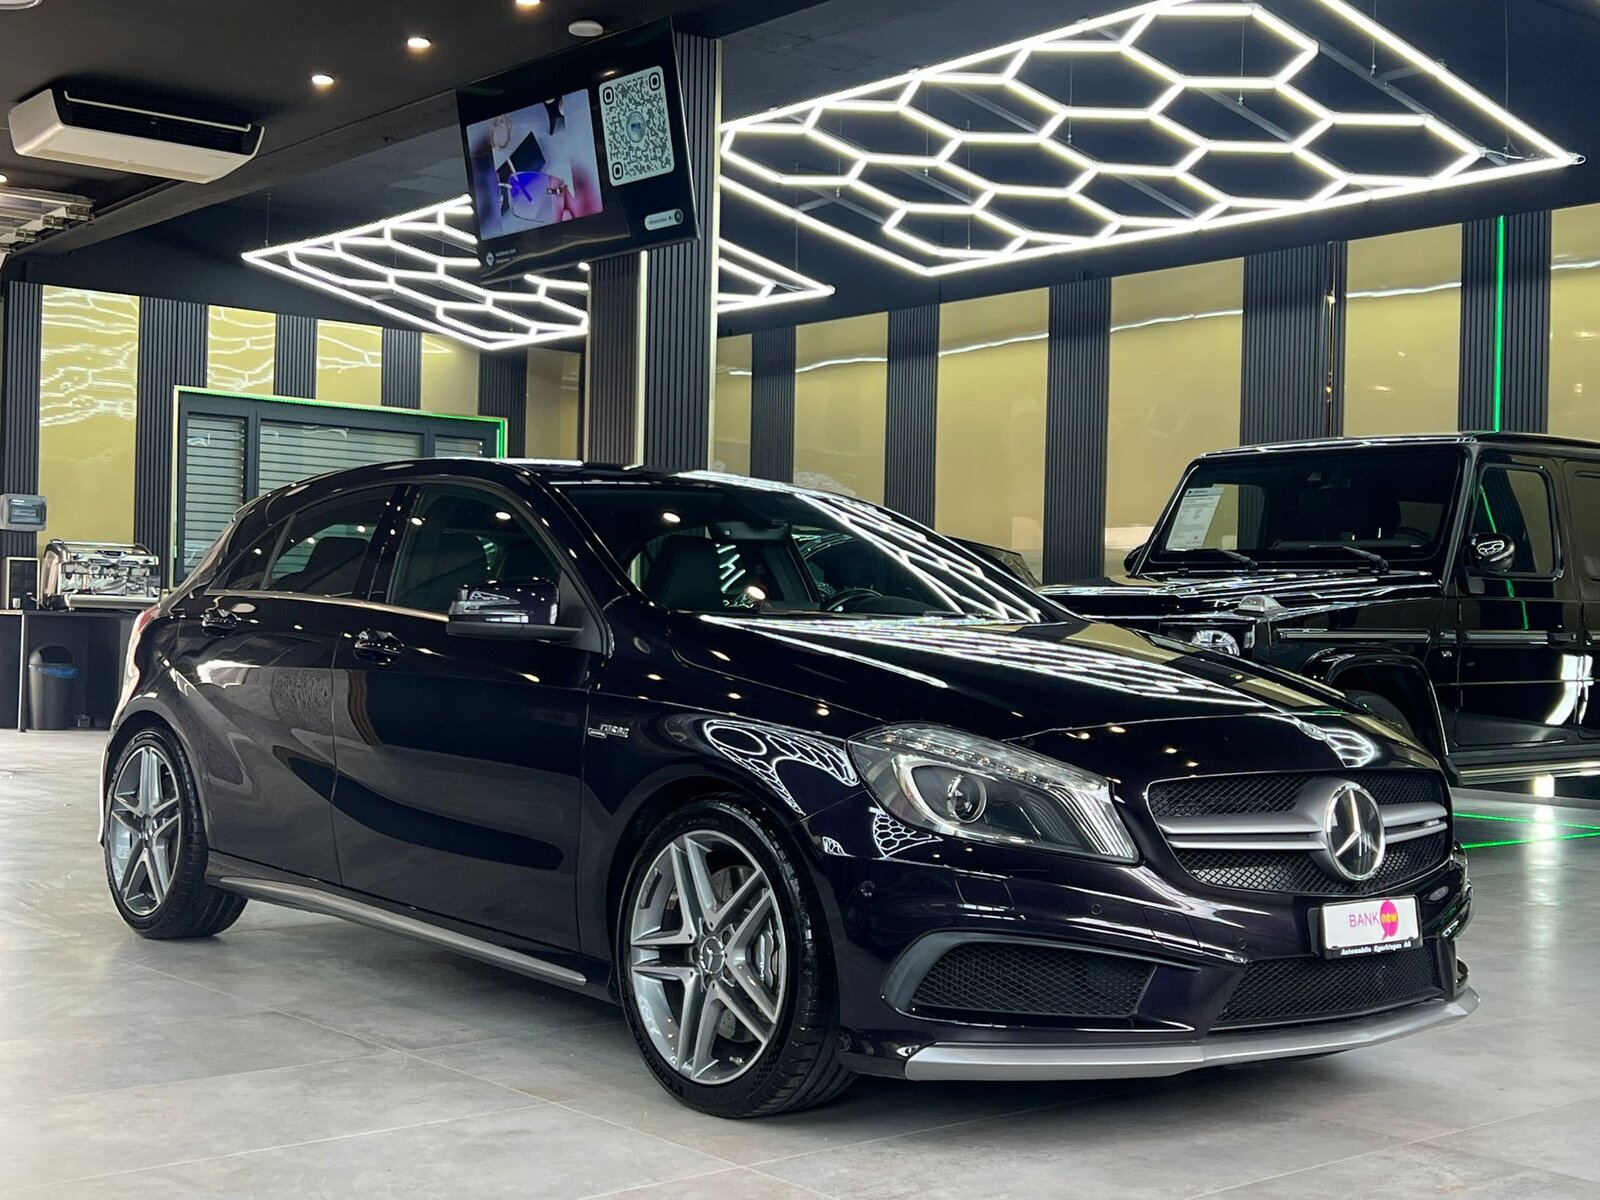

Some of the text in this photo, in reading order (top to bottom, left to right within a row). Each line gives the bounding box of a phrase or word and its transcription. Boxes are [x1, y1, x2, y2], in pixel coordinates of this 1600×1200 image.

[1349, 912, 1398, 928] BANK now
[1341, 946, 1372, 956] Automobile
